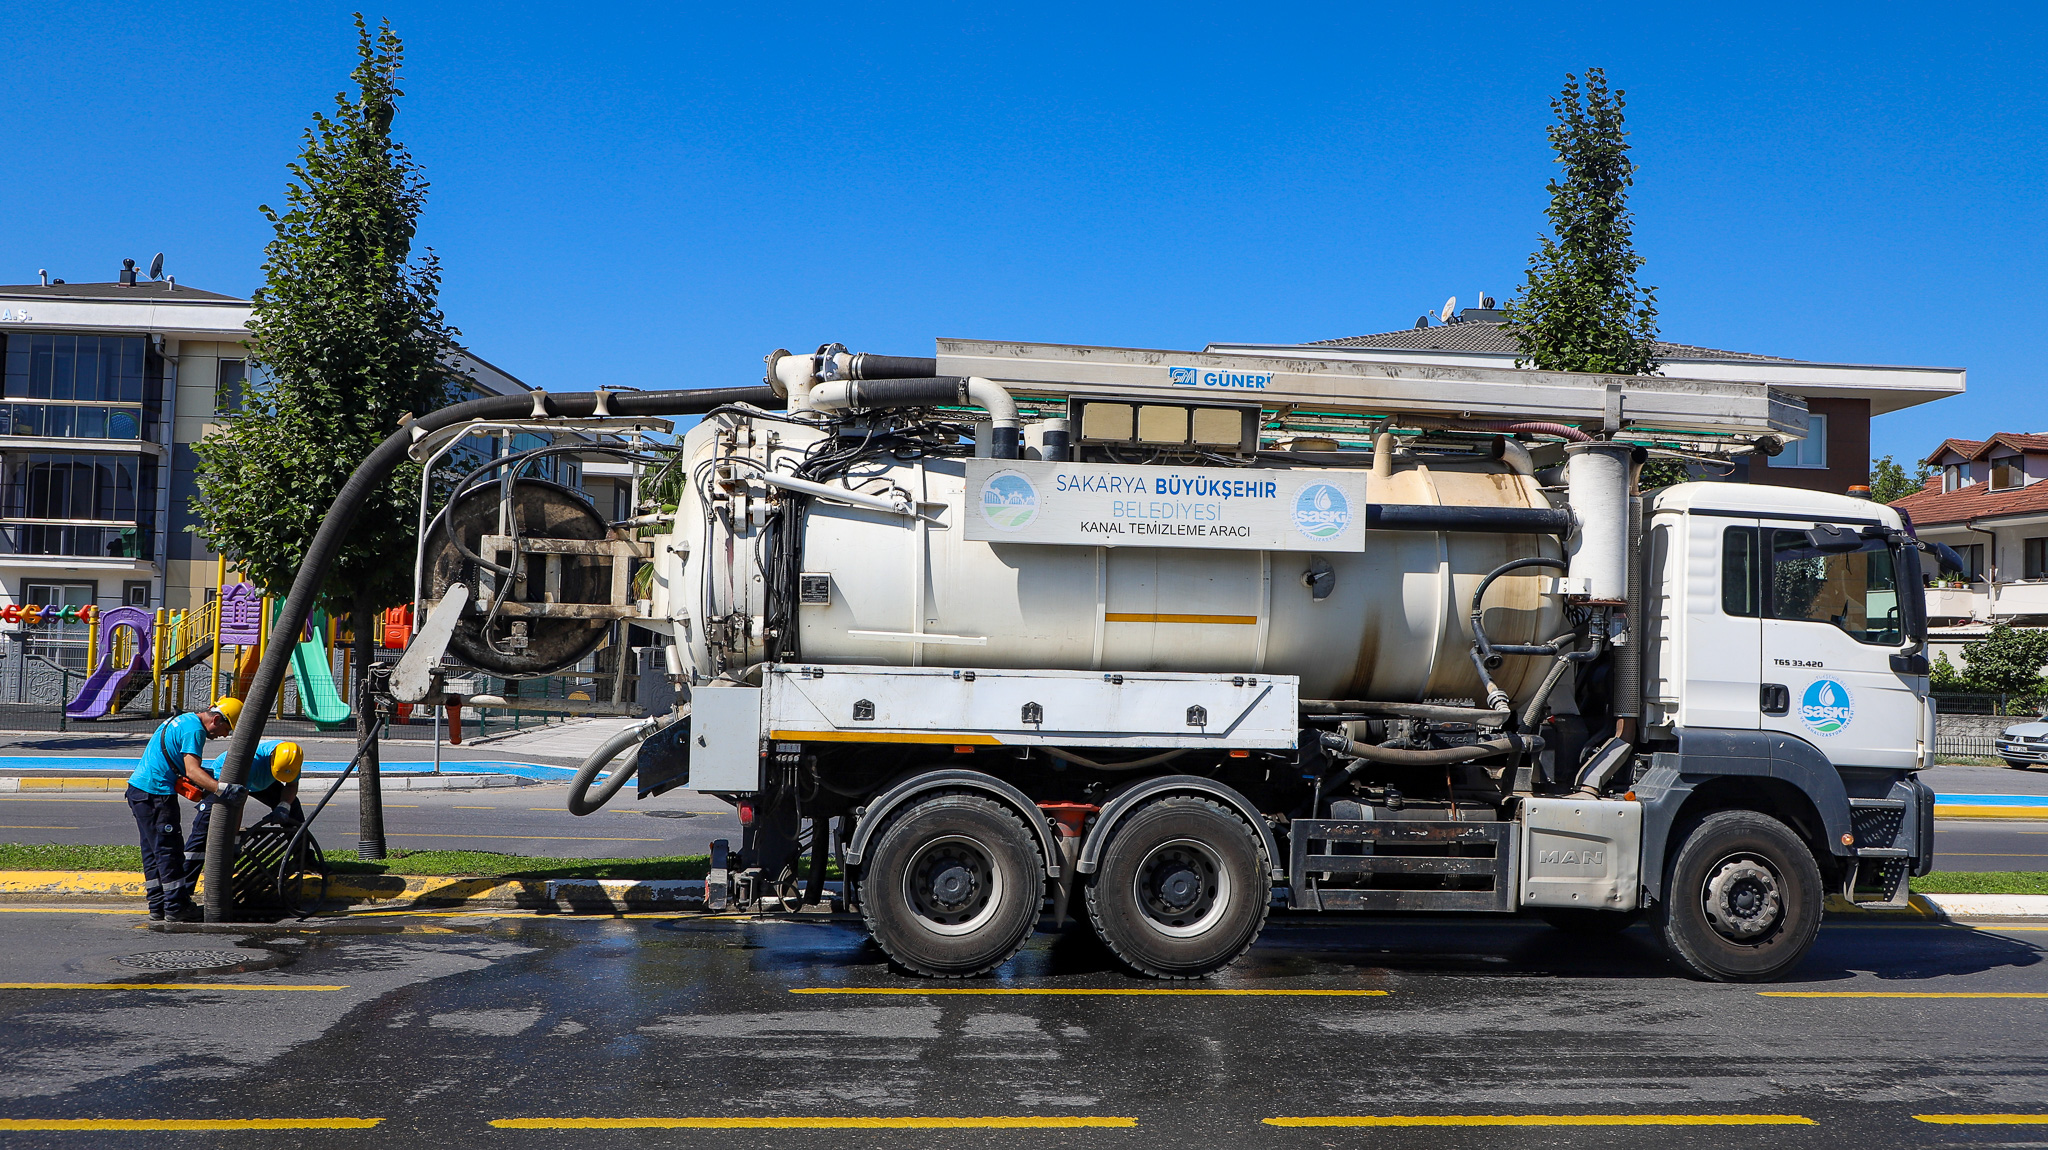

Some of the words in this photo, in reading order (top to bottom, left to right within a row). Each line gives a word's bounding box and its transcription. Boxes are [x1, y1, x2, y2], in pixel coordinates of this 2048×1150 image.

[2, 308, 33, 324] A.Ş.
[1056, 474, 1147, 494] SAKARYA
[1155, 474, 1277, 500] BÜYÜKŞEHİR
[1113, 500, 1221, 521] BELEDİYESİ
[1080, 521, 1126, 534] KANAL
[1209, 525, 1251, 537] ARACI
[1773, 658, 1790, 666] TGS
[1792, 659, 1824, 668] 33.420
[1539, 850, 1603, 865] MAN
